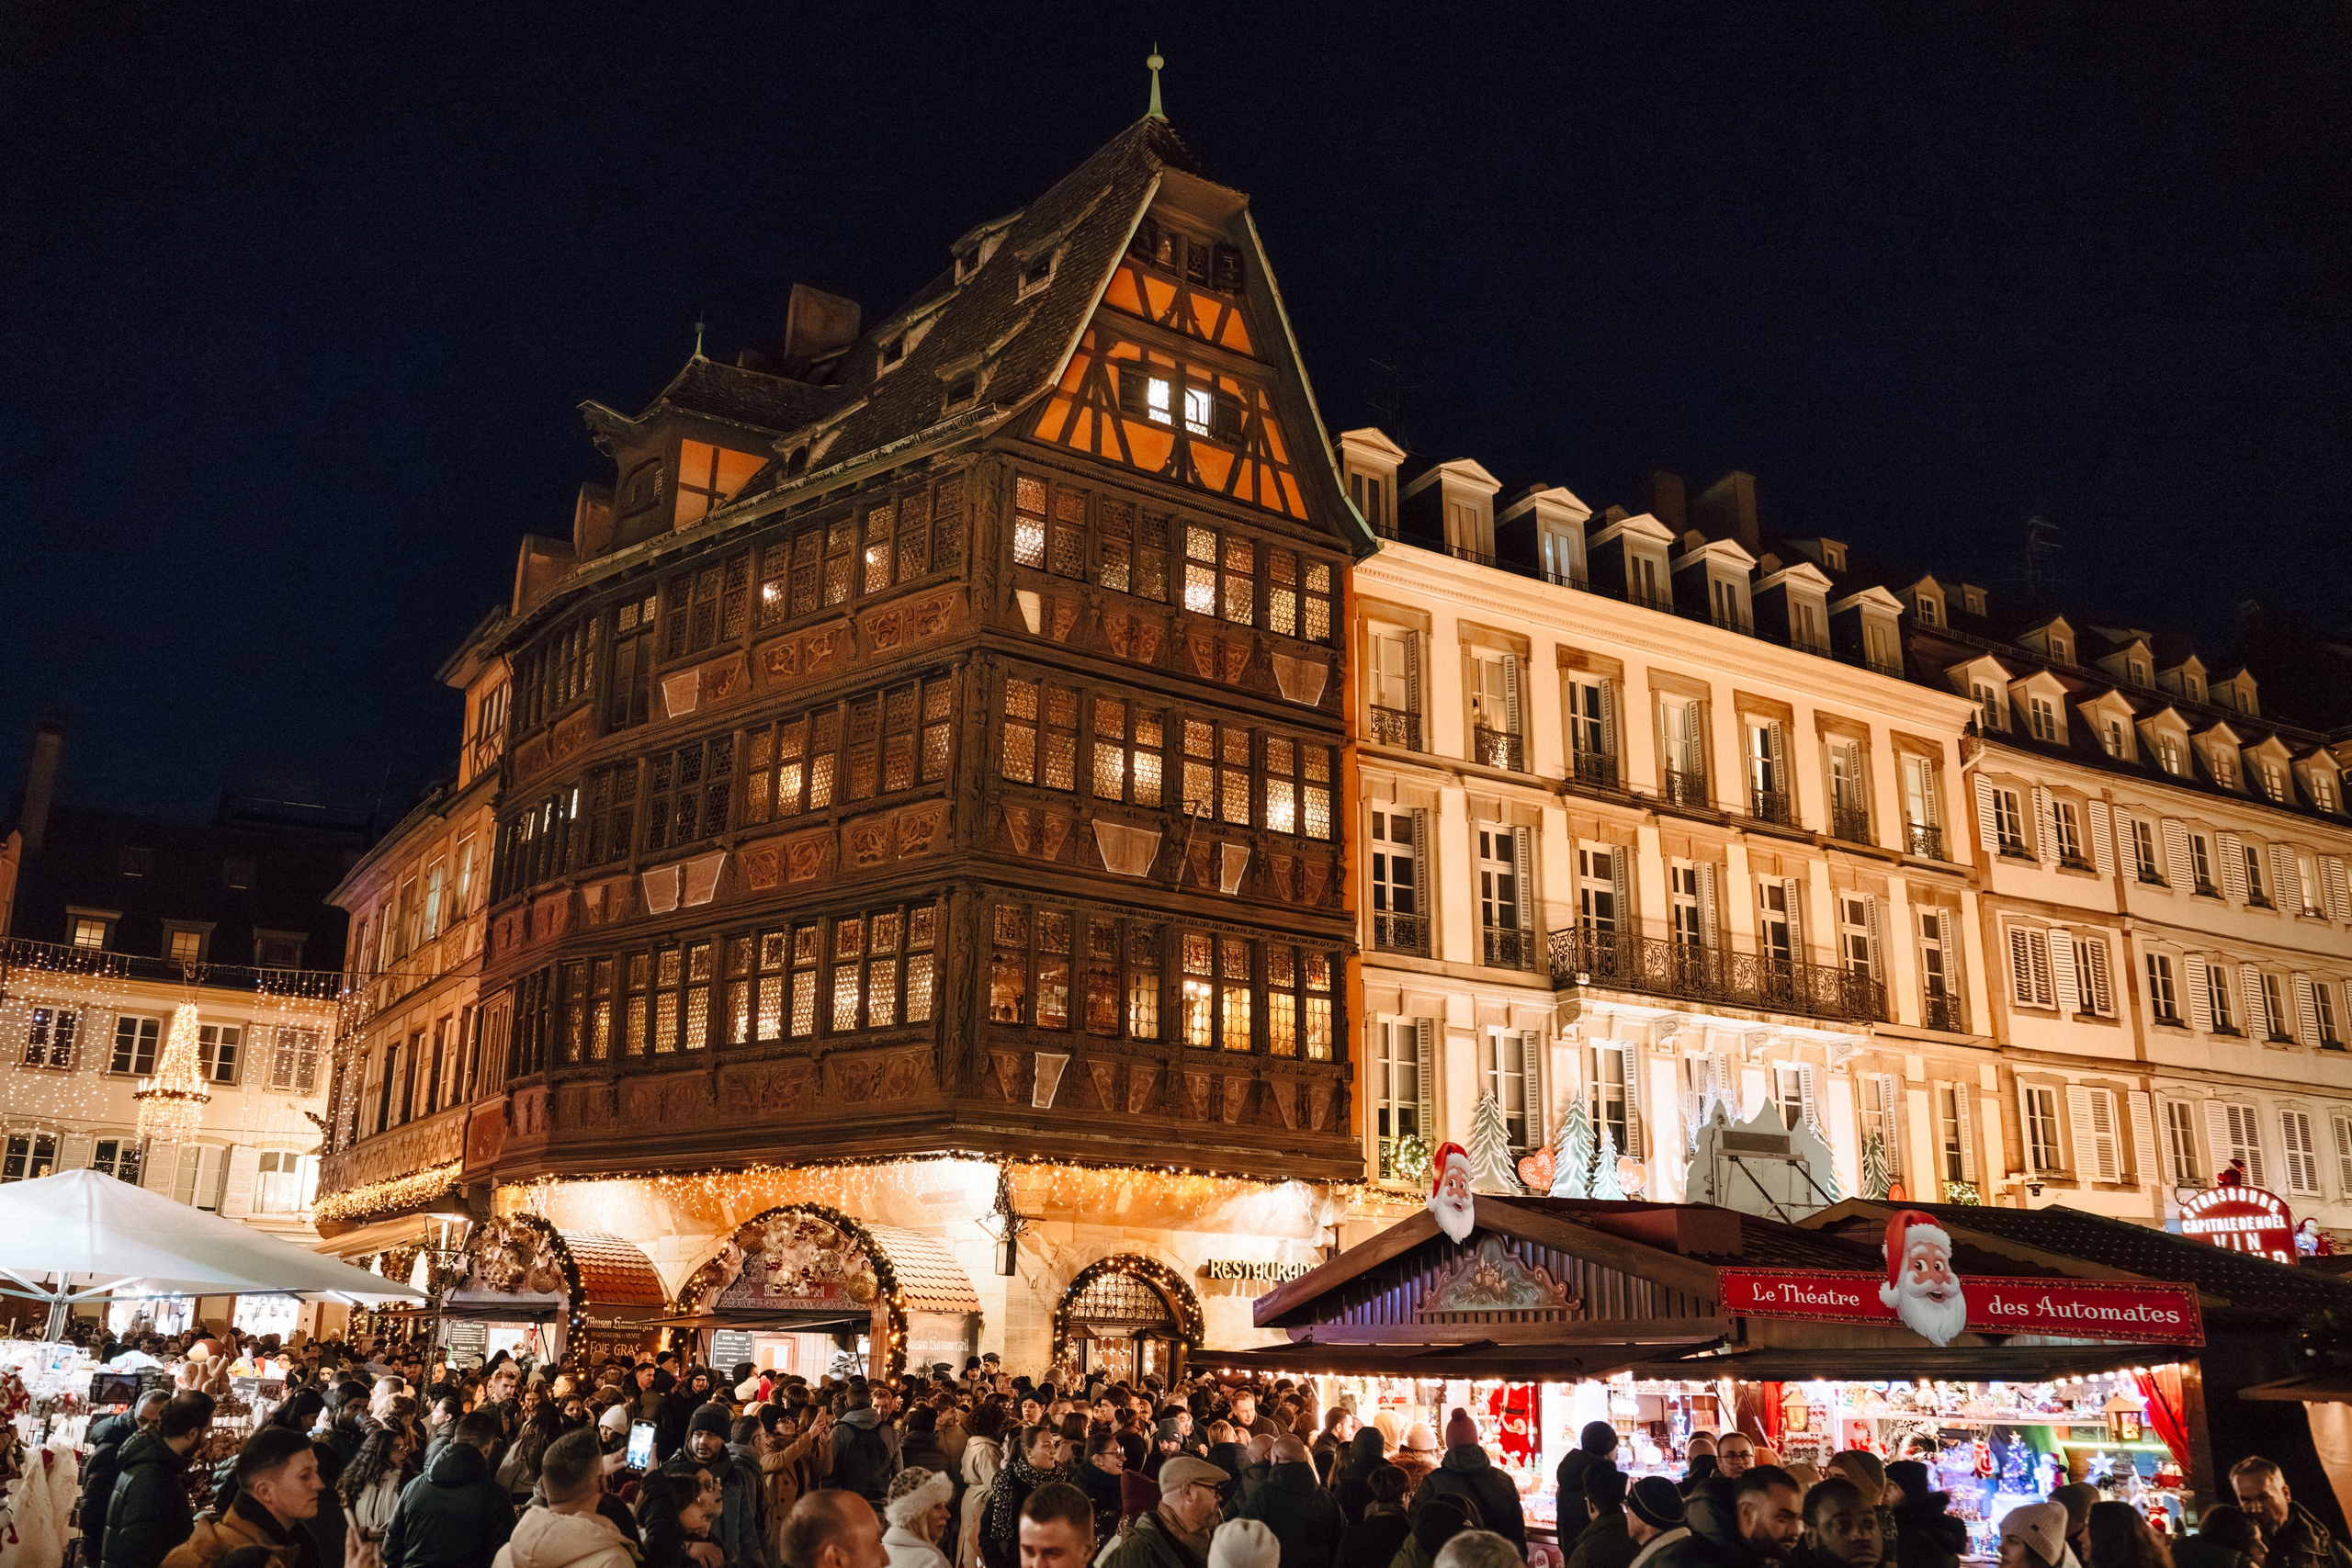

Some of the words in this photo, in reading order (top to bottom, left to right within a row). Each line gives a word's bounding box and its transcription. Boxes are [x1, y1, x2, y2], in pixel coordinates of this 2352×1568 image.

[2181, 1187, 2280, 1219] STRASBOURG
[2181, 1218, 2238, 1234] CAPITALE
[2238, 1216, 2256, 1231] DE
[2256, 1213, 2288, 1229] NOËL
[2212, 1233, 2262, 1252] VIN
[1752, 1282, 1776, 1302] Le
[1778, 1283, 1860, 1306] Théatre
[1988, 1295, 2030, 1316] des
[2036, 1296, 2181, 1324] Automates
[585, 1316, 612, 1329] Maison
[589, 1340, 611, 1356] FOIE
[911, 1357, 924, 1369] VIN
